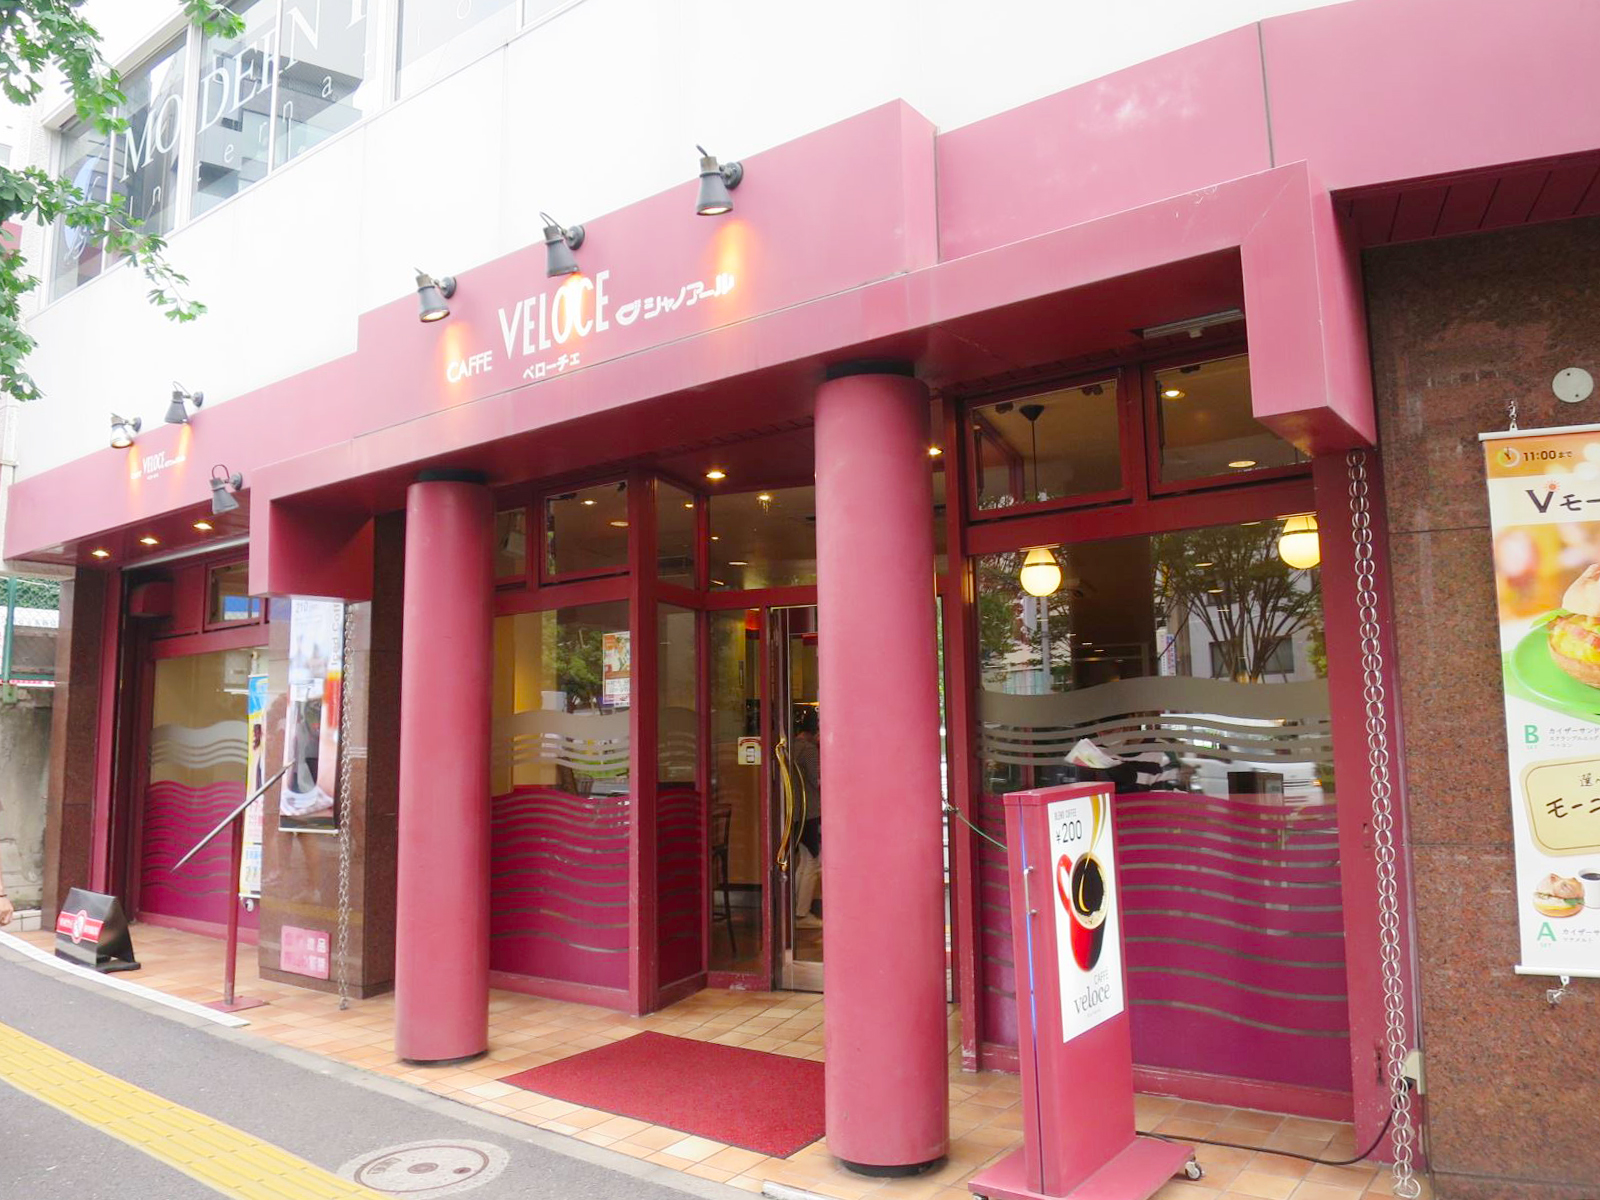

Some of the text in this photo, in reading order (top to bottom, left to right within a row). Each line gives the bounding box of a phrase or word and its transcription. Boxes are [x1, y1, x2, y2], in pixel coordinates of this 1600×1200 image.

[643, 272, 736, 320] シャノアール
[498, 270, 610, 359] VELOCE
[446, 350, 493, 383] CAFFE
[522, 352, 581, 379] ベローチェ
[1524, 724, 1540, 744] B
[1055, 819, 1083, 845] ¥200
[1536, 921, 1558, 942] A
[1073, 983, 1111, 1014] veloce
